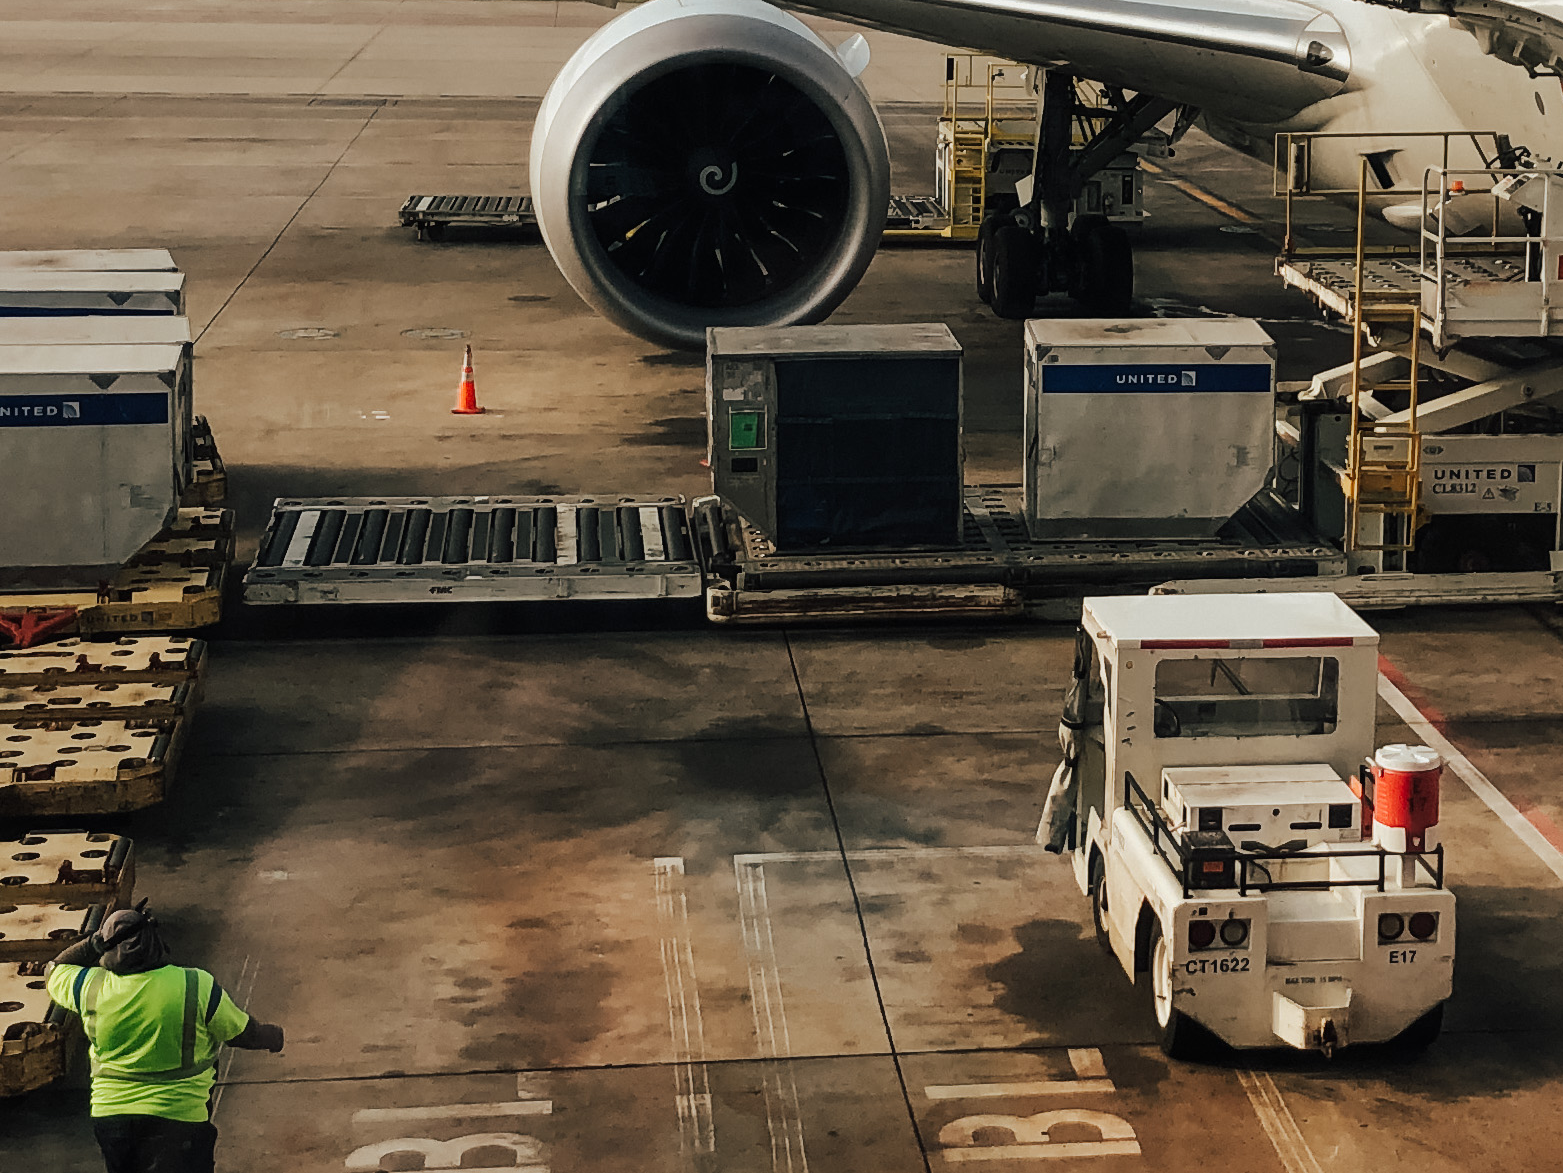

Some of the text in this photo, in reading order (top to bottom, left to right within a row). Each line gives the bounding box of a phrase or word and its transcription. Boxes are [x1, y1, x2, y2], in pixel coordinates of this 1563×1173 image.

[1116, 374, 1178, 384] UNITED
[0, 406, 58, 417] NITED
[1434, 469, 1512, 480] UNITED
[1389, 950, 1417, 964] E17
[1185, 957, 1250, 975] CT1622
